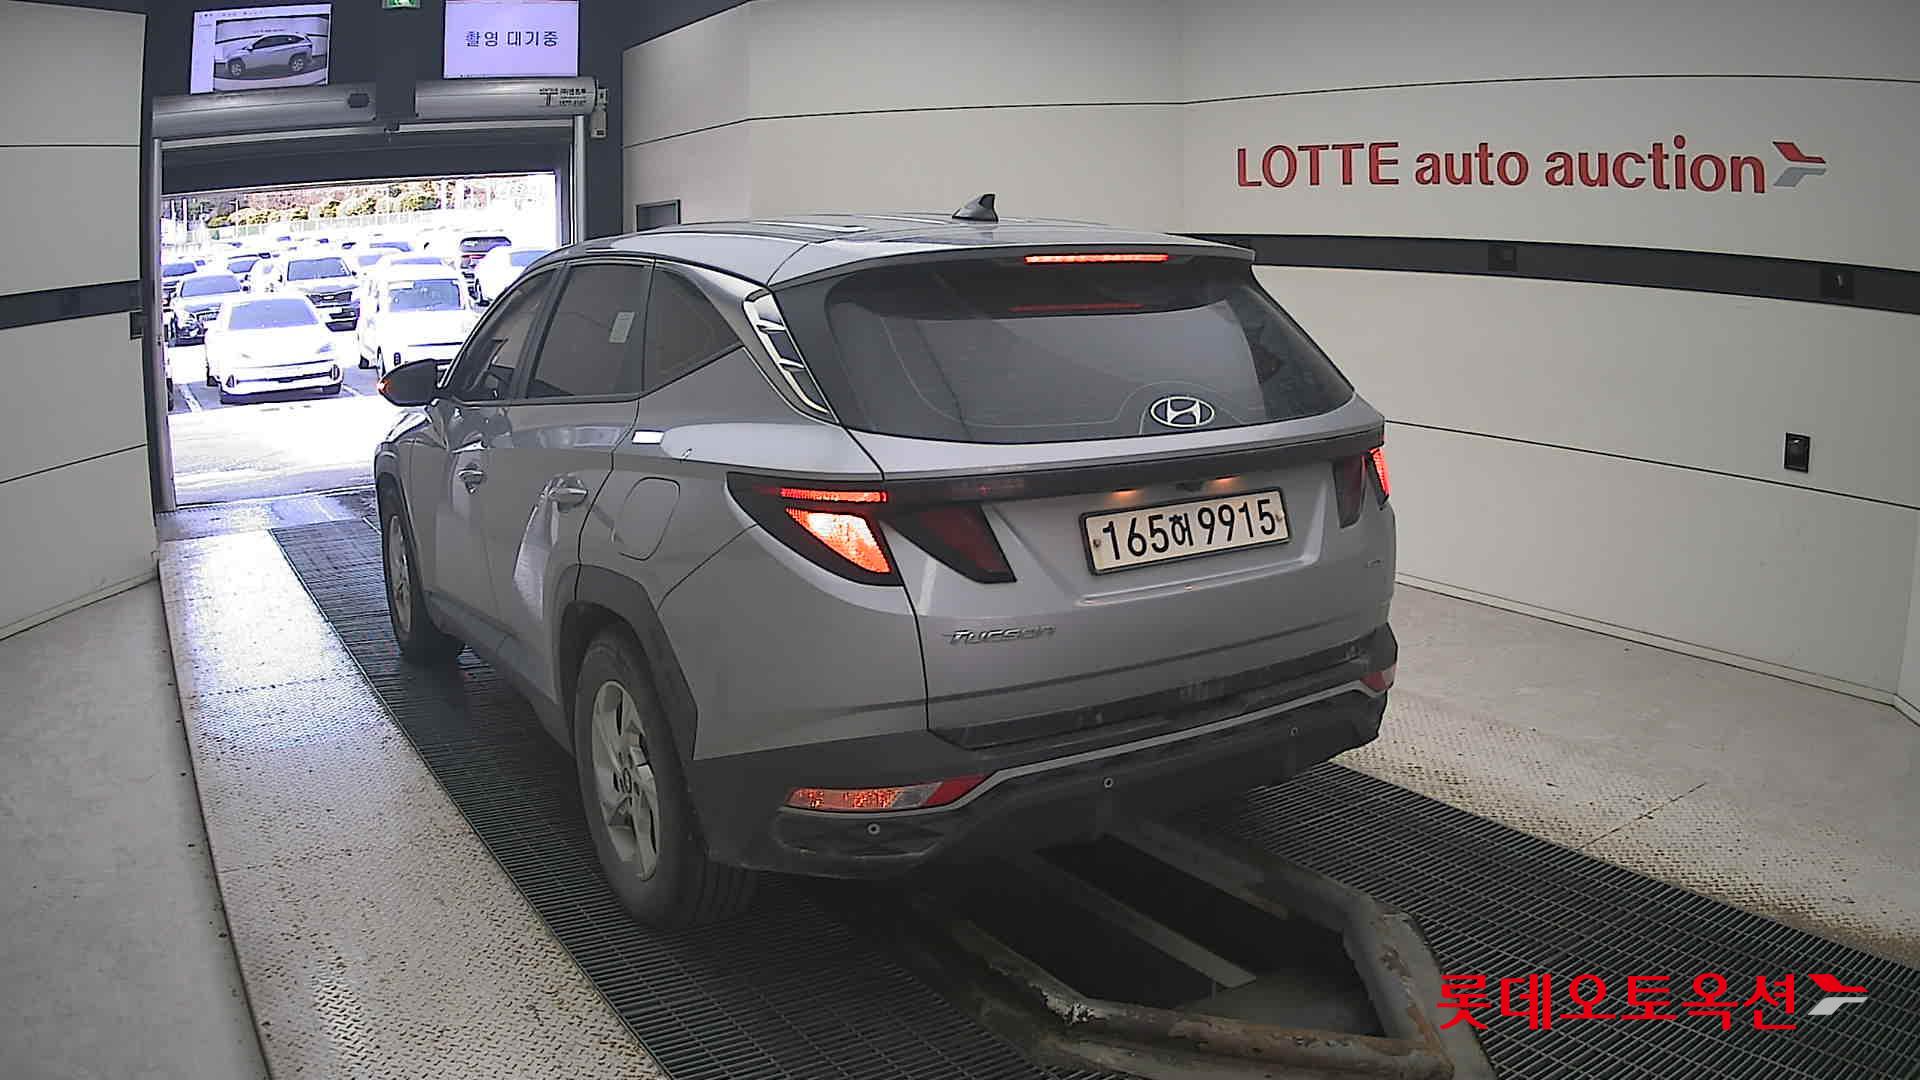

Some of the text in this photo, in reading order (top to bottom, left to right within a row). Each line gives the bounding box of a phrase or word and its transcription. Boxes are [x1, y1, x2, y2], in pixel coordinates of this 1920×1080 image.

[466, 31, 558, 47] 촬영 대기중
[1237, 135, 1765, 193] LOTTE auto auction
